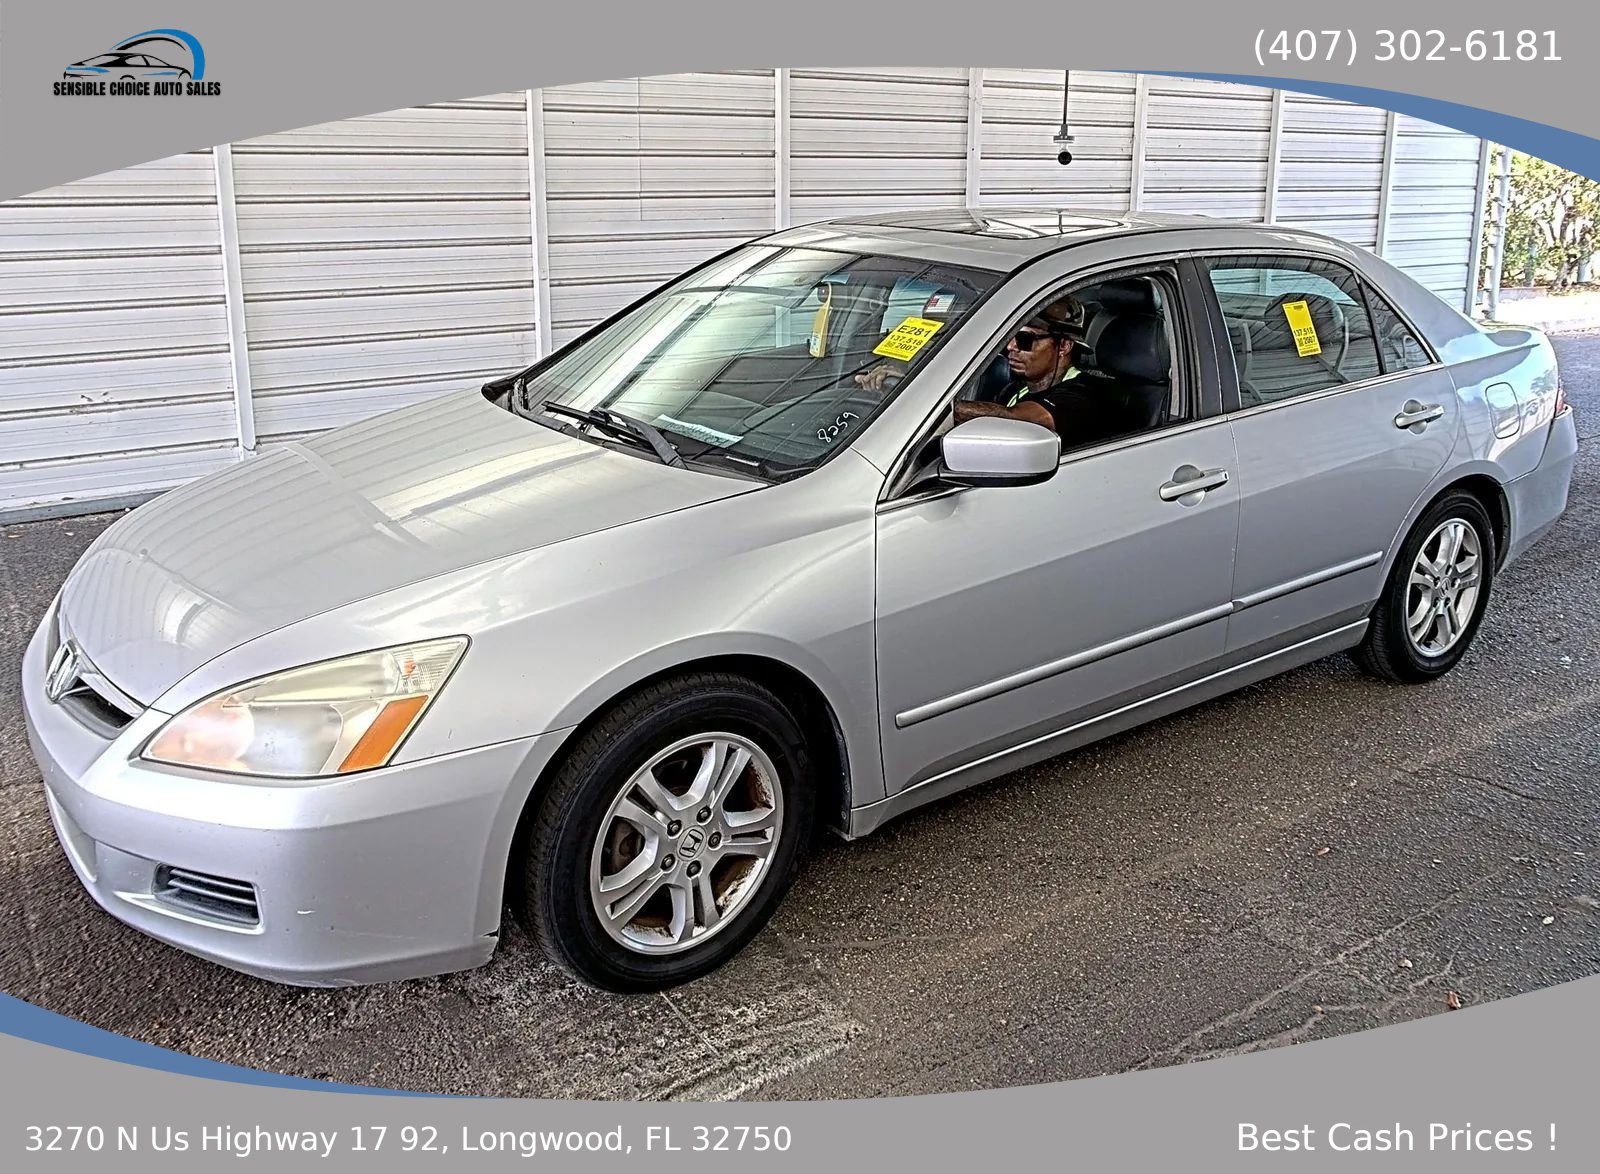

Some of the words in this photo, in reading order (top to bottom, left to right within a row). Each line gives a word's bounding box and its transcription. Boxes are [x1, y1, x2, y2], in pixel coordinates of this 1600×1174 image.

[897, 324, 932, 338] E281
[895, 342, 918, 352] 2007
[816, 411, 860, 443] 8259
